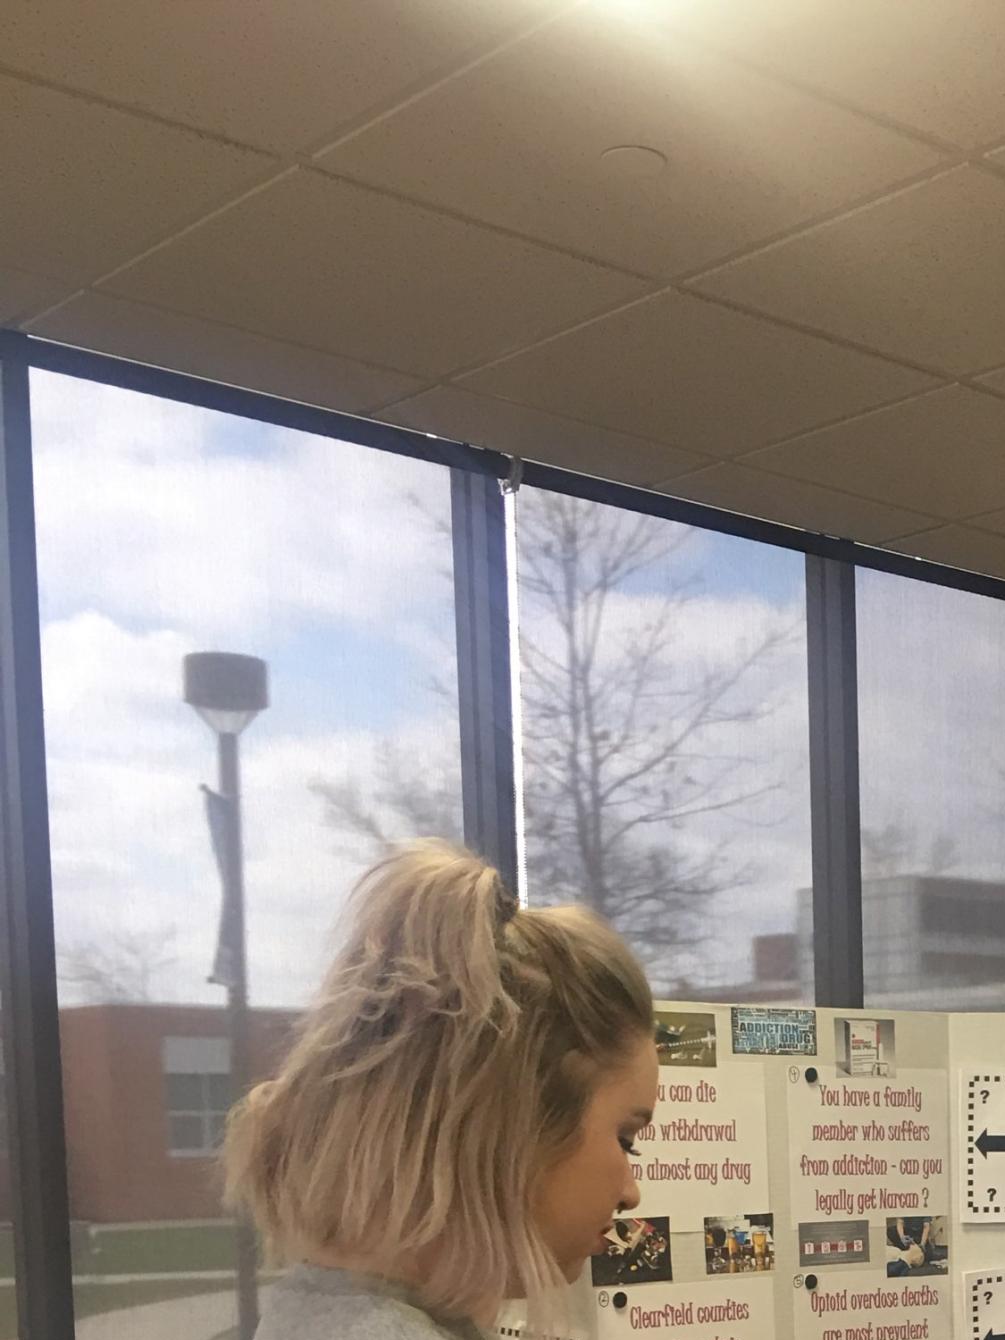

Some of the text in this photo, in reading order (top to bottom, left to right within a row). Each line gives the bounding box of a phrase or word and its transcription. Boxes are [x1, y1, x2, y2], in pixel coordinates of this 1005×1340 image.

[740, 1022, 800, 1034] ADDICTION
[781, 1033, 811, 1044] DRUG
[669, 1084, 692, 1102] can
[696, 1079, 717, 1103] die
[819, 1084, 922, 1112] You have a family
[637, 1118, 737, 1141] om withdrawal
[812, 1120, 930, 1141] member who suffers
[647, 1158, 691, 1181] almost
[694, 1162, 718, 1185] any
[722, 1158, 751, 1185] drug
[800, 1154, 829, 1176] from
[833, 1154, 888, 1176] addiction
[900, 1159, 920, 1175] can
[923, 1158, 943, 1179] you
[815, 1188, 854, 1216] legally
[857, 1188, 877, 1215] get
[879, 1188, 919, 1209] Narcan
[811, 1285, 939, 1317] Opioid overdose deaths
[630, 1299, 749, 1329] Clearfield counties
